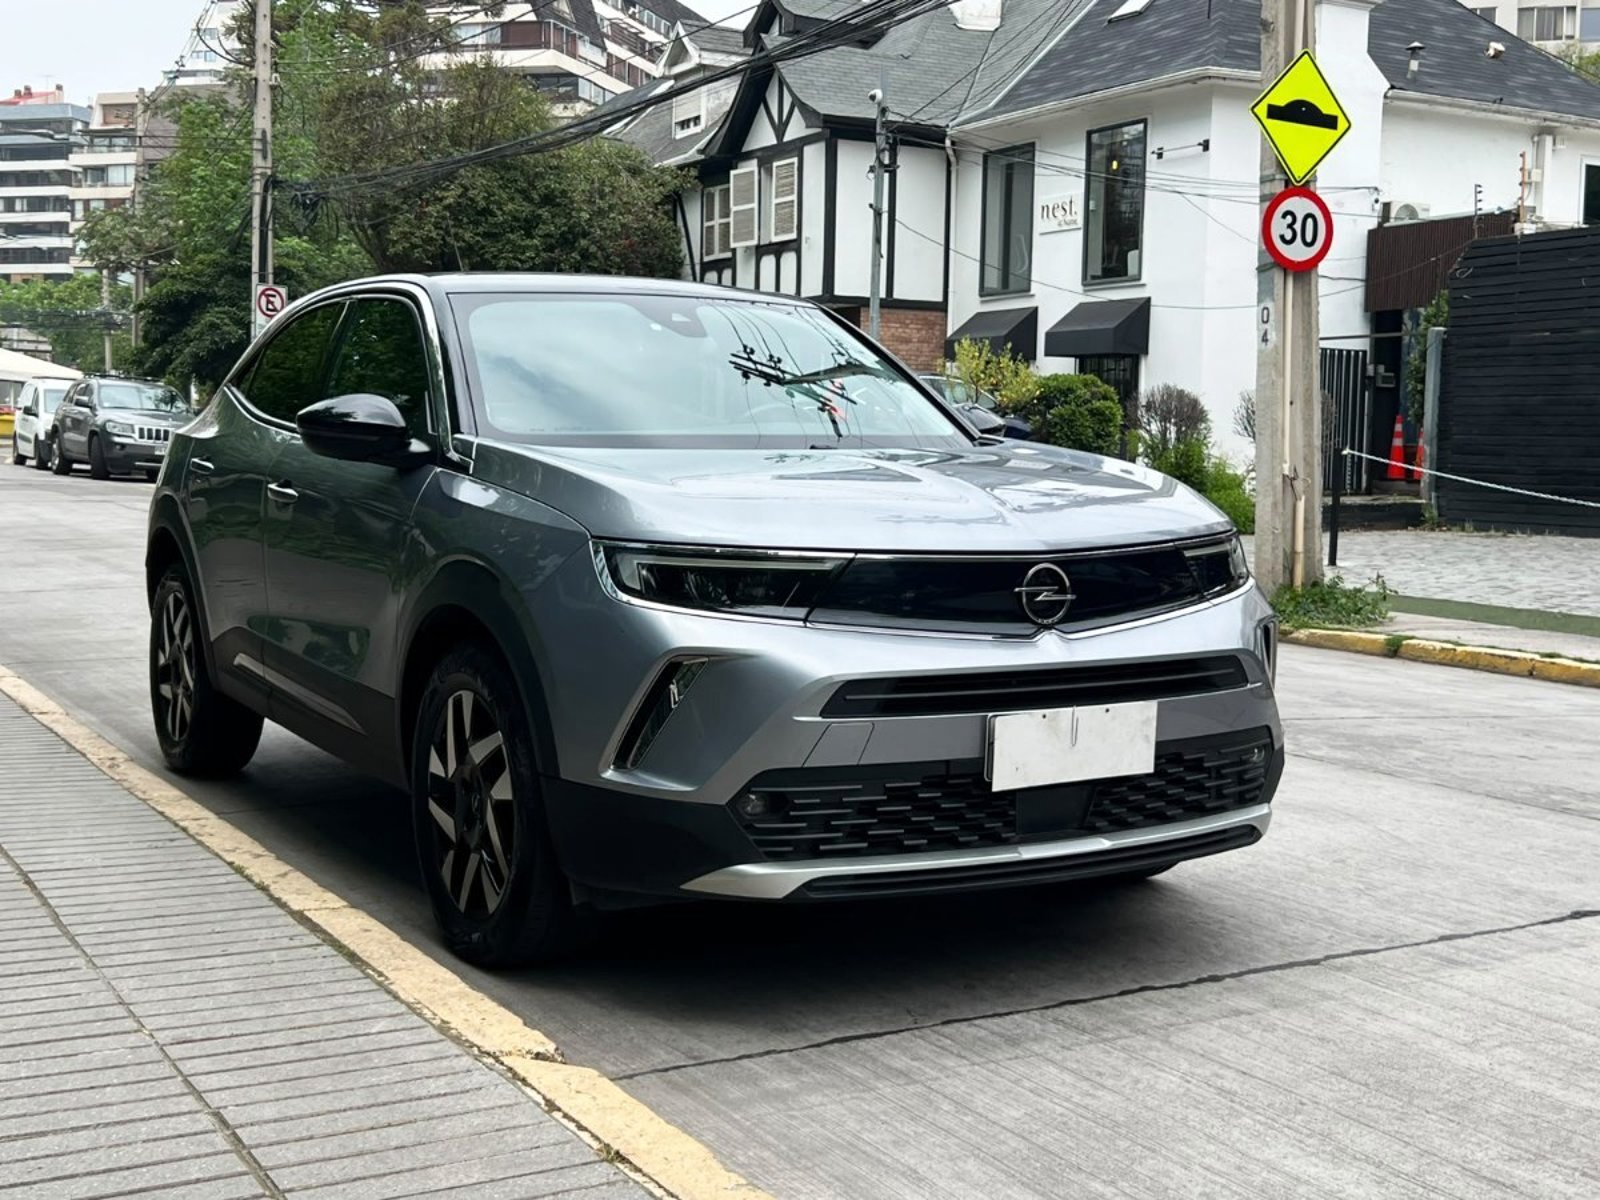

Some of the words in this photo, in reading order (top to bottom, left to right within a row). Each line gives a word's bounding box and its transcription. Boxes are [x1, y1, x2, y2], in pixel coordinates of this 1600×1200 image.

[1040, 195, 1077, 220] nest.
[1279, 210, 1318, 248] 30
[265, 293, 278, 312] E
